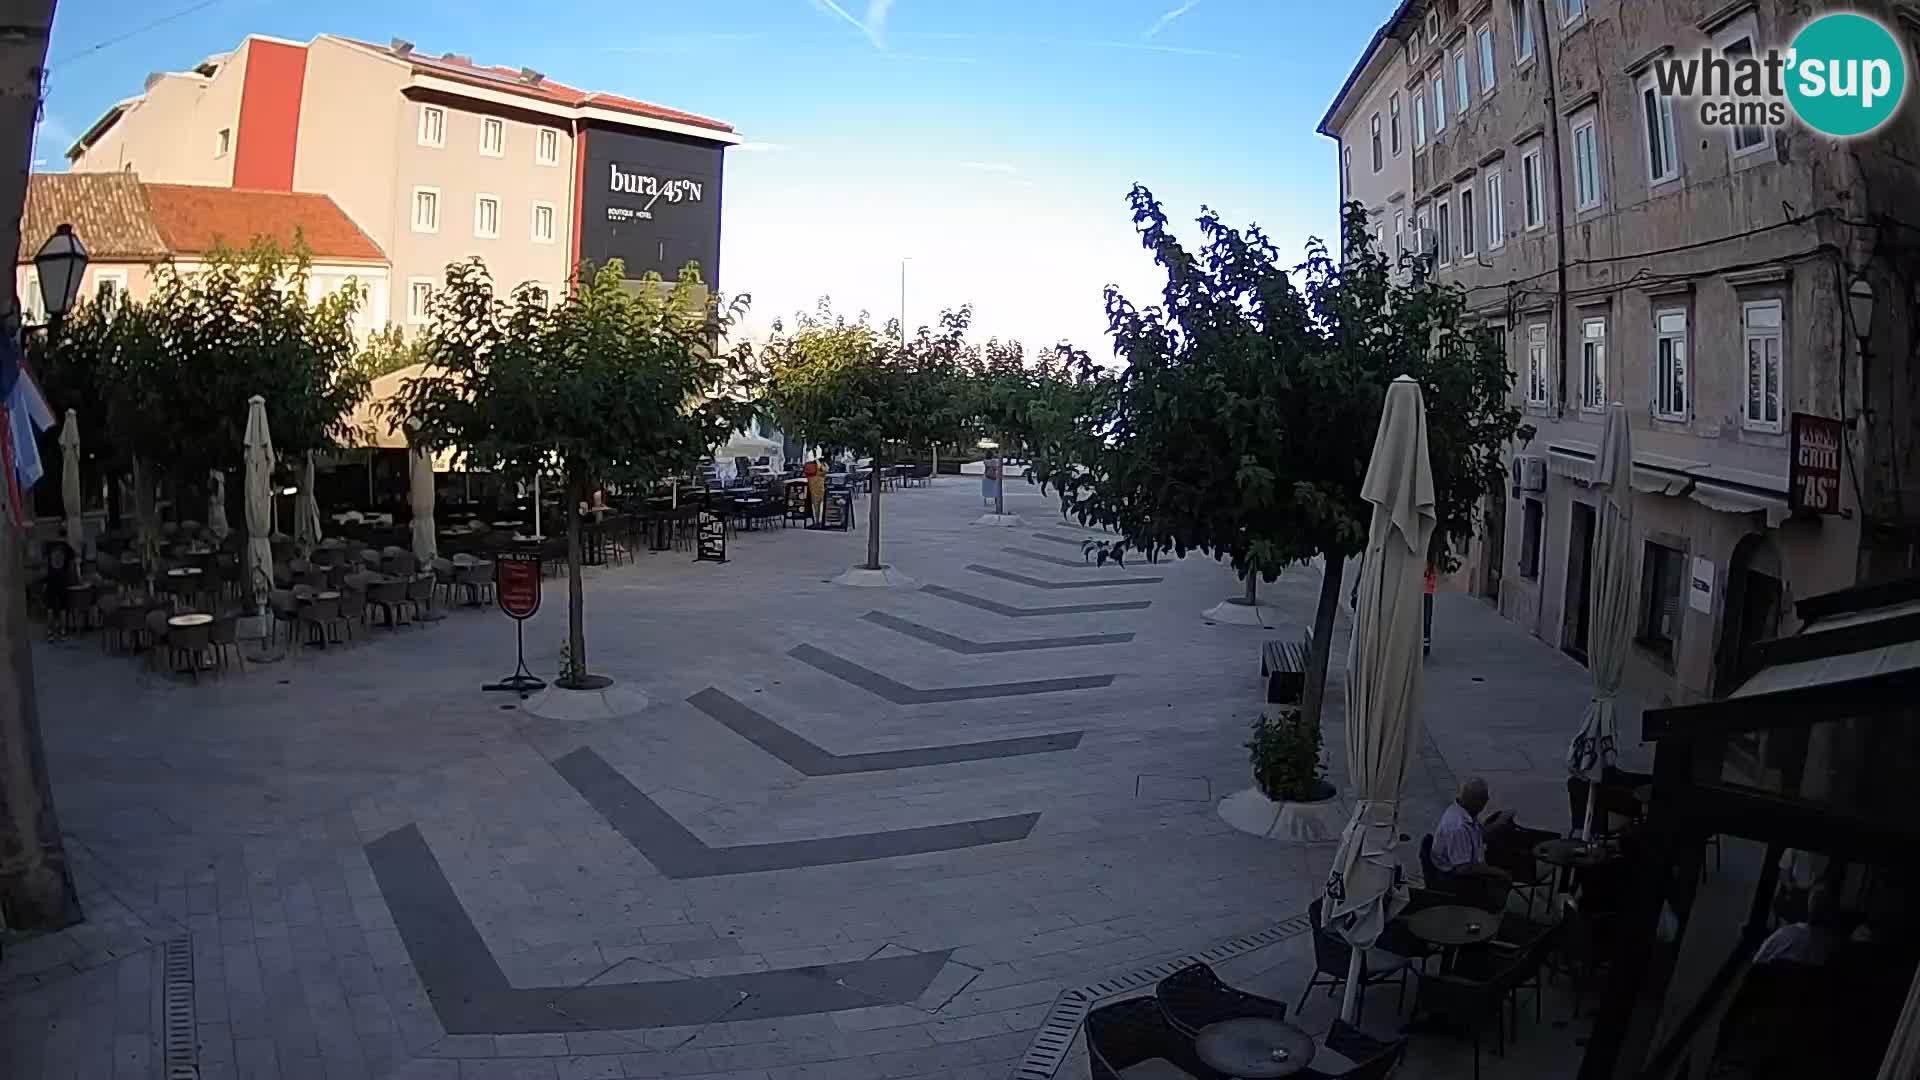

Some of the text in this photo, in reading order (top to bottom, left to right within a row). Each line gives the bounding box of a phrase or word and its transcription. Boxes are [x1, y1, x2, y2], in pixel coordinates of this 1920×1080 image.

[610, 164, 657, 195] bura
[607, 207, 653, 219] BOUTIQUE HOTEL
[1798, 447, 1838, 471] GRILL
